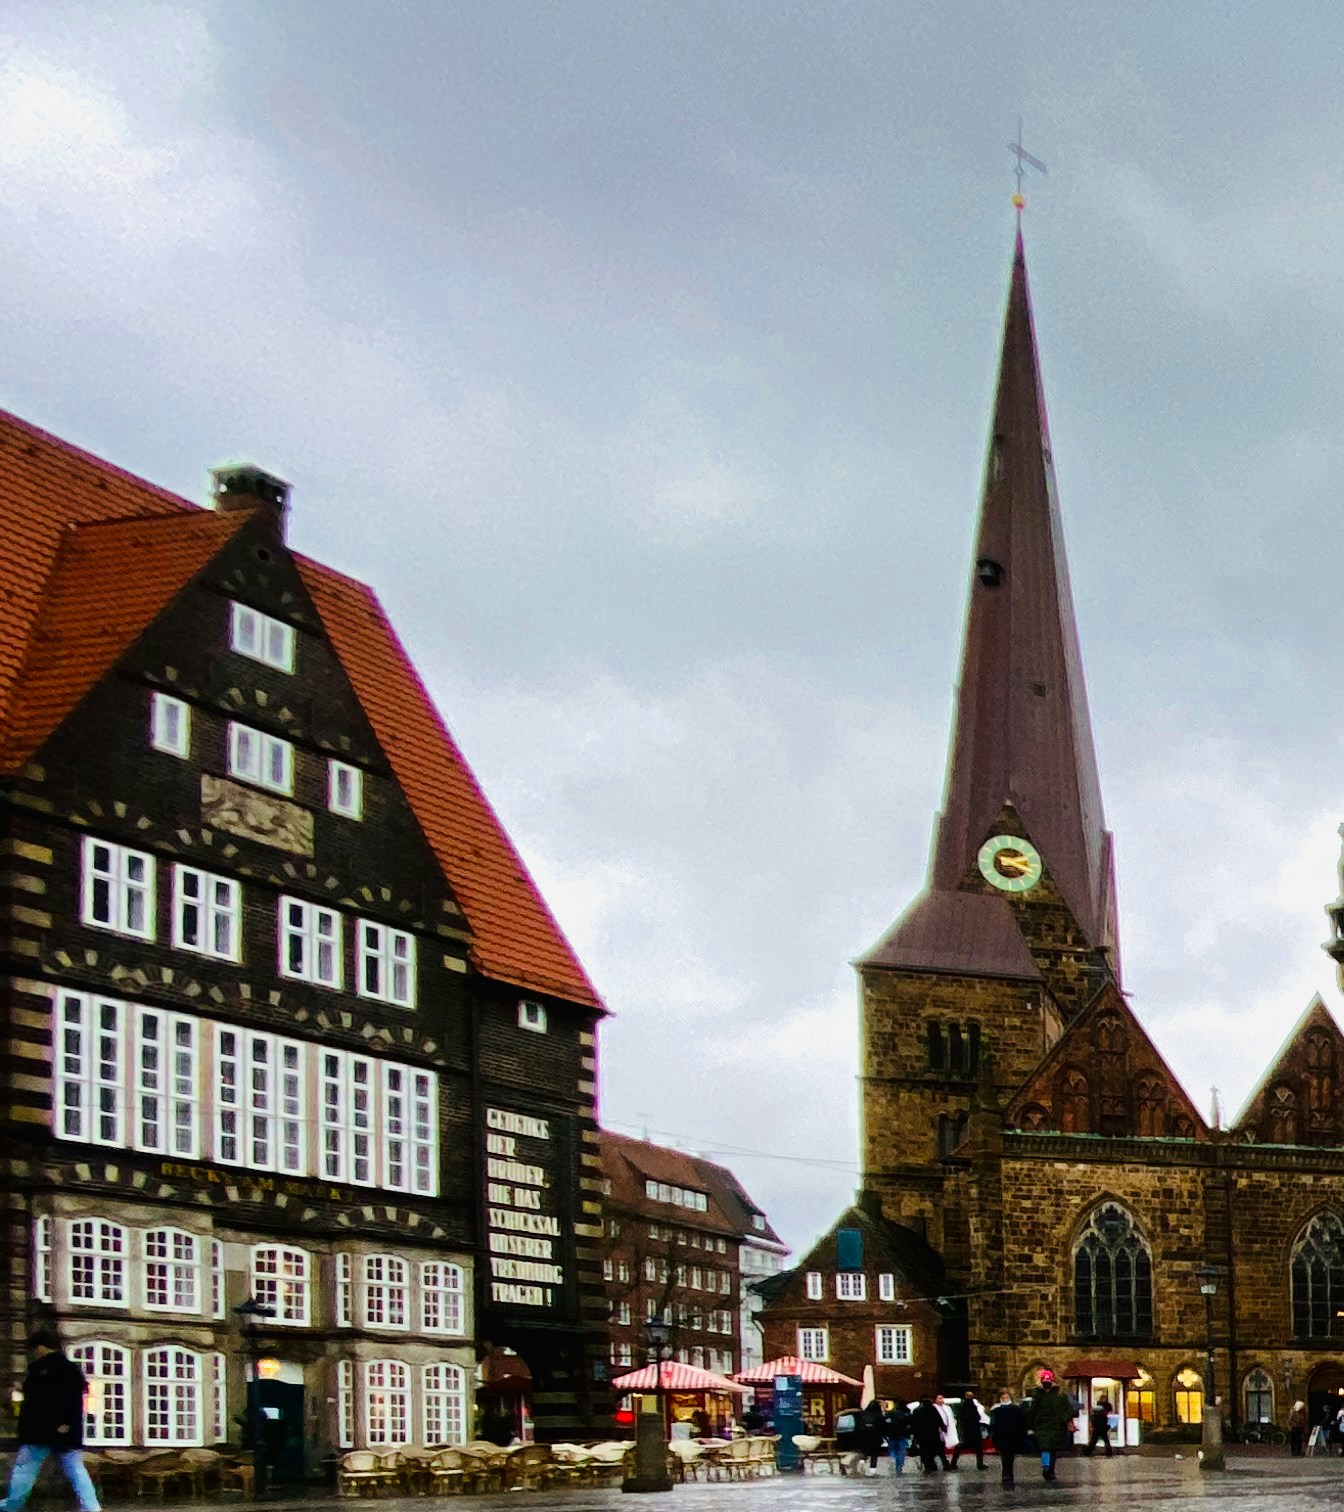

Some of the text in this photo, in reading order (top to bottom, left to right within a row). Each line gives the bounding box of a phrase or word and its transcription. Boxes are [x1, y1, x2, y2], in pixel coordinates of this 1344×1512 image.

[487, 1134, 516, 1157] DER
[488, 1183, 541, 1210] DIE DAS
[489, 1208, 561, 1236] SCHICKSAL
